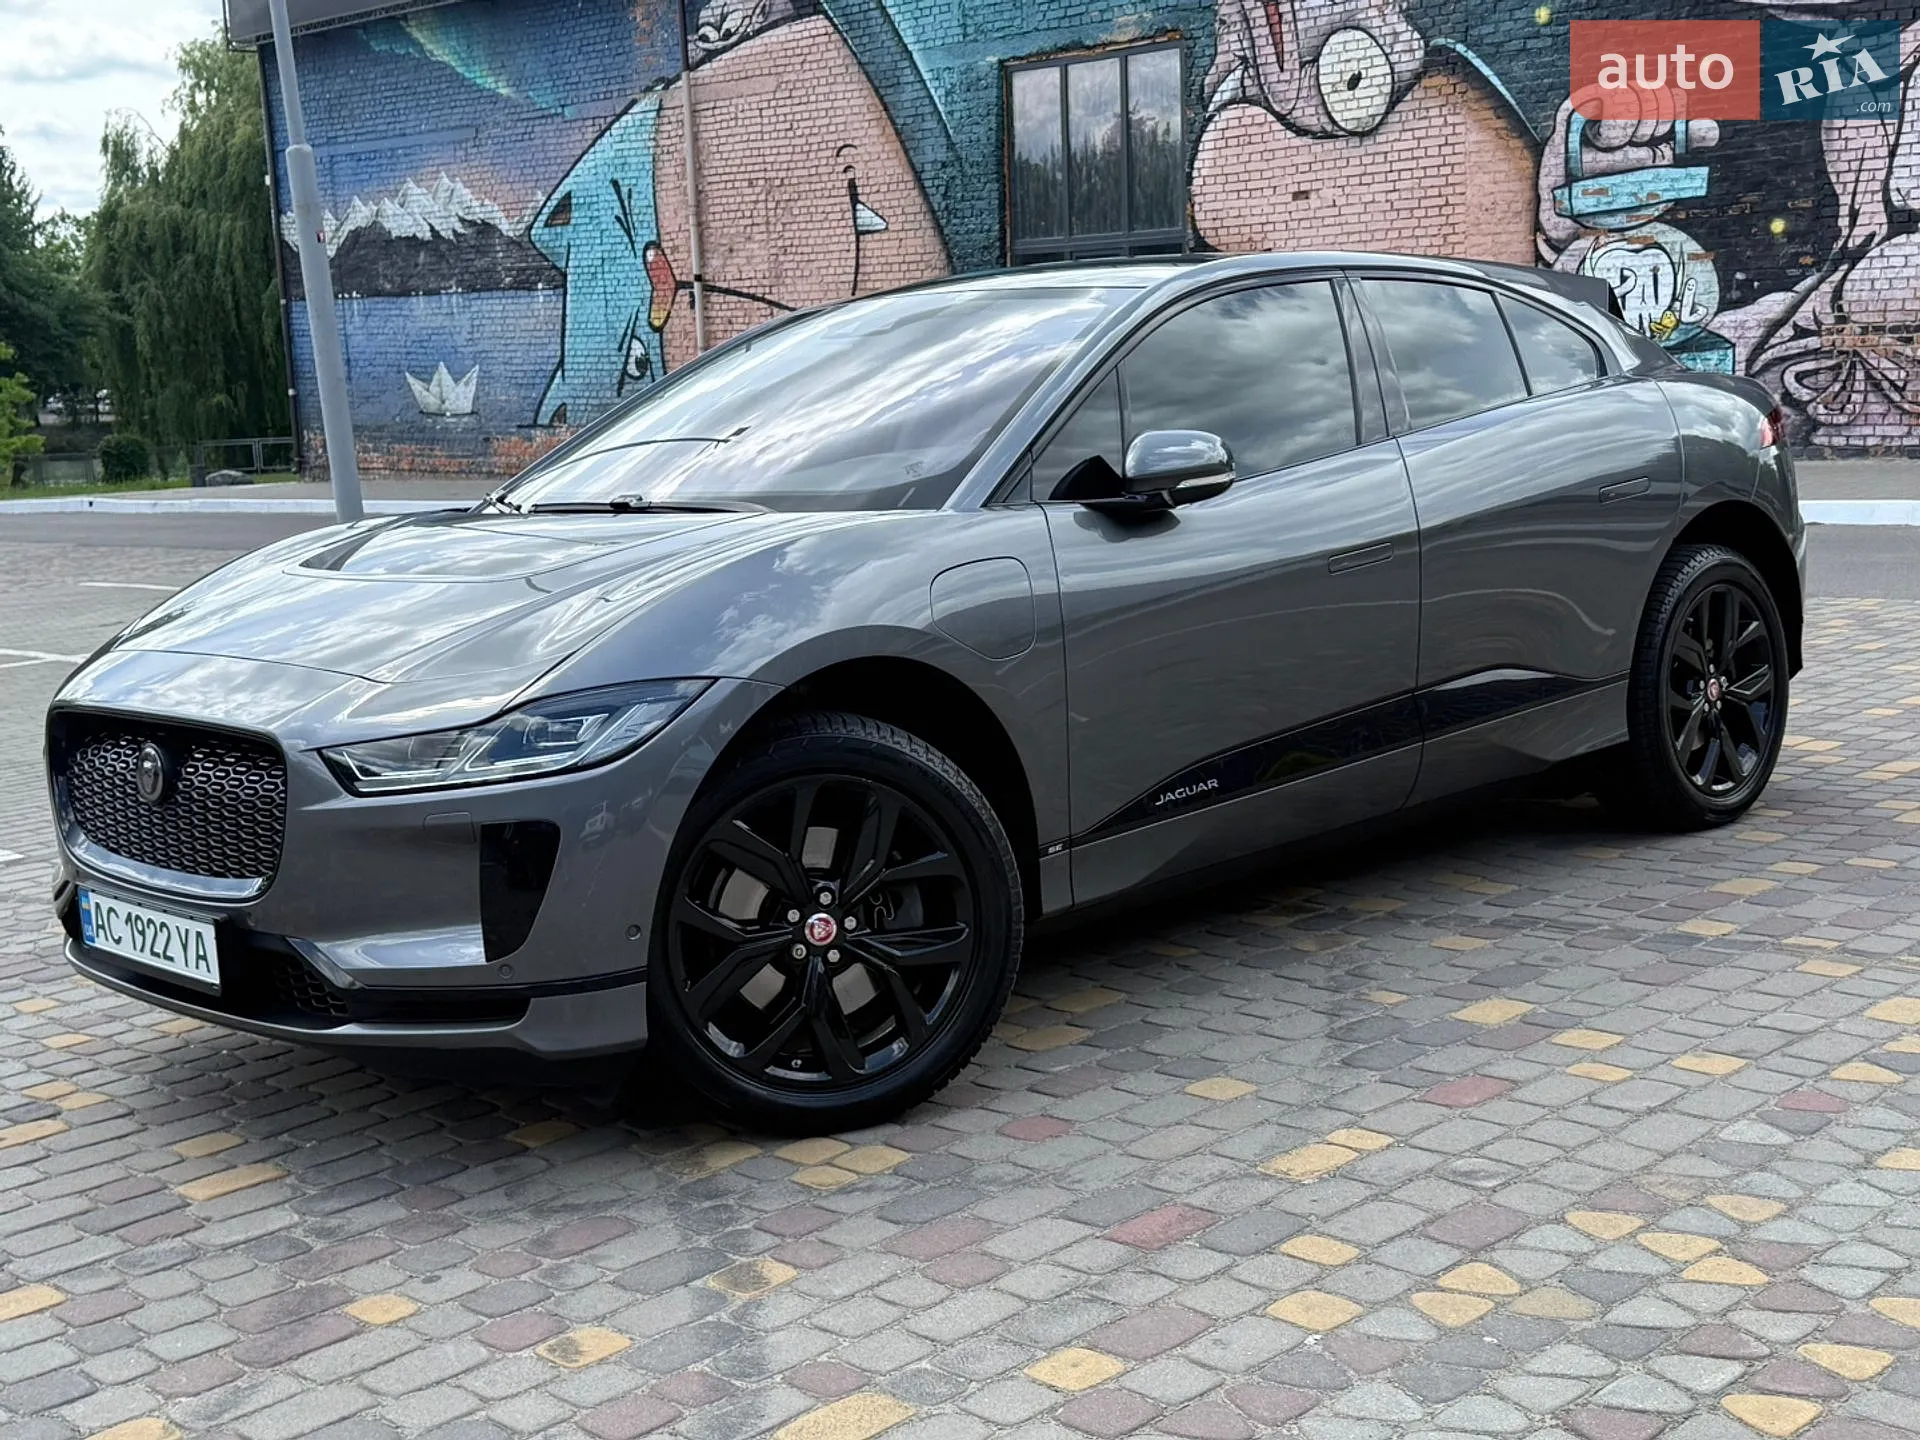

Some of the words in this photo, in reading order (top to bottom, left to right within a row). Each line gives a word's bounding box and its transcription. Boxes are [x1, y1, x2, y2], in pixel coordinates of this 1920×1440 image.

[1155, 779, 1219, 806] JAGUAR
[95, 901, 122, 945] AC
[125, 911, 175, 963] 1922
[175, 924, 211, 974] YA
